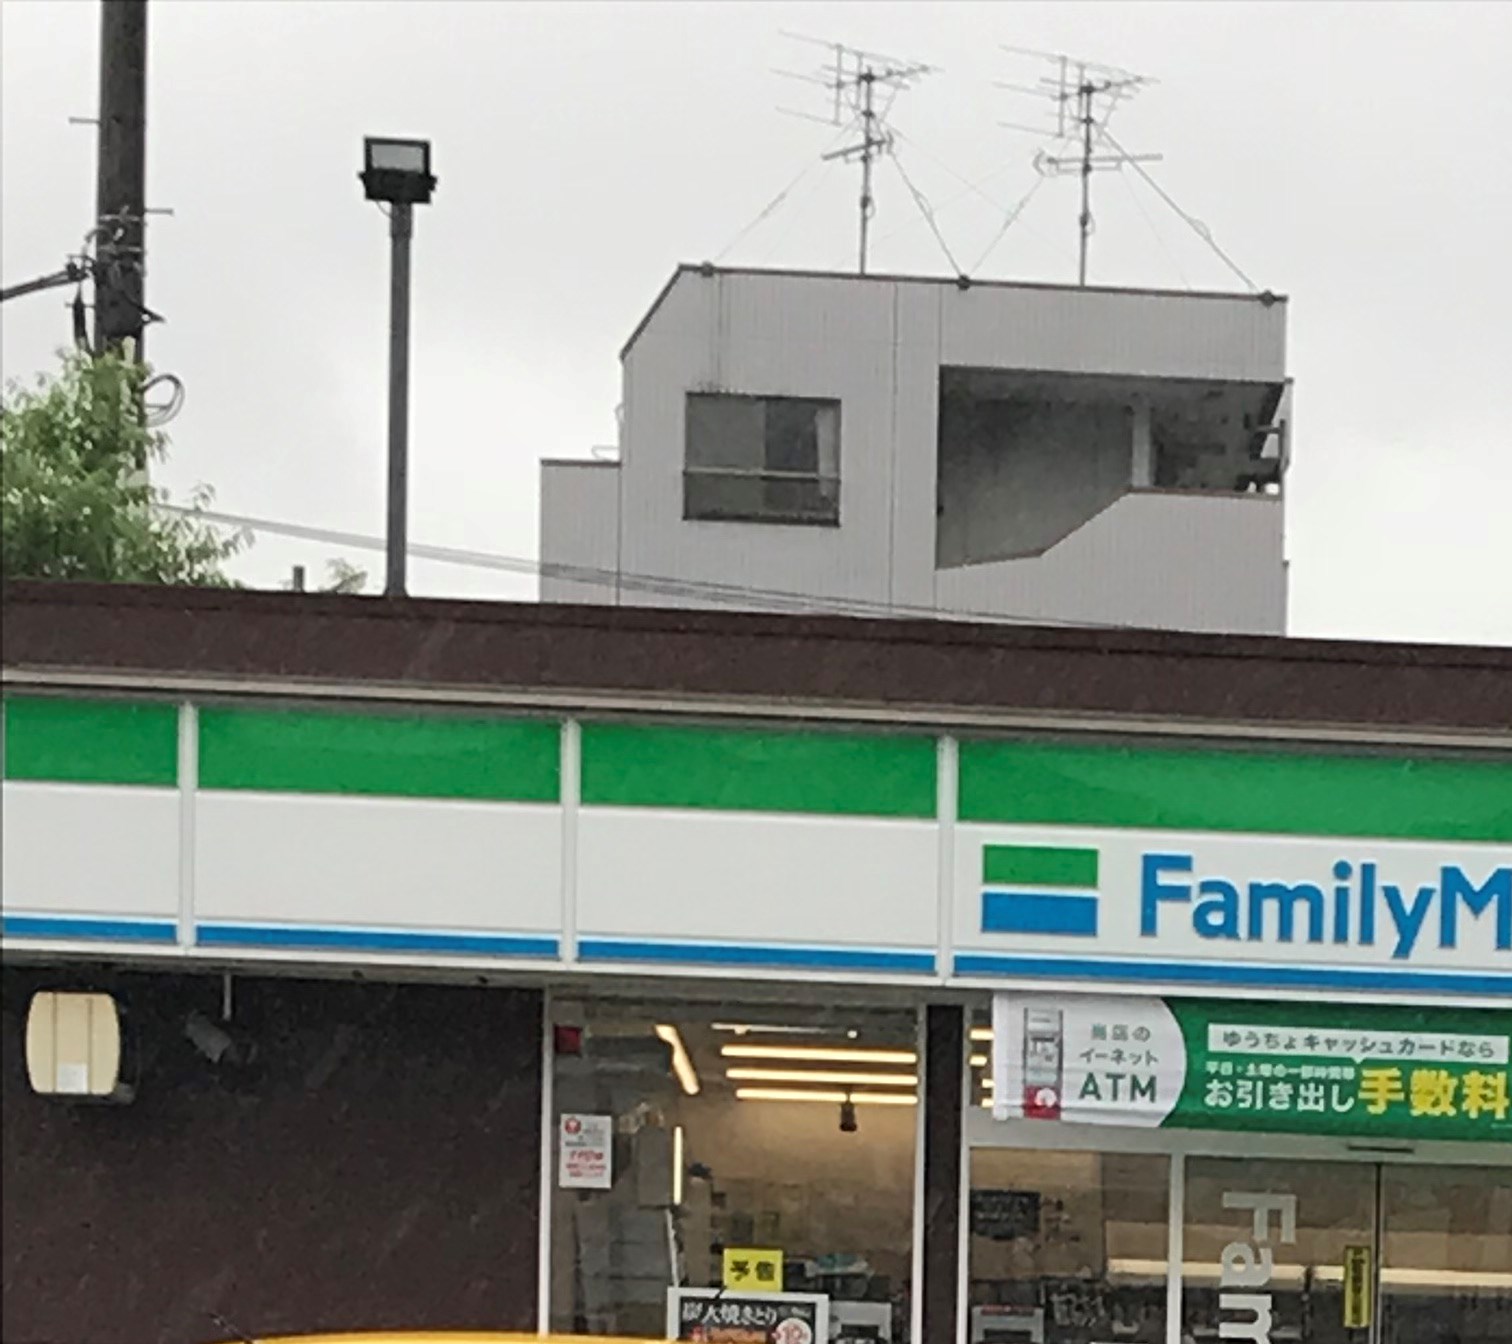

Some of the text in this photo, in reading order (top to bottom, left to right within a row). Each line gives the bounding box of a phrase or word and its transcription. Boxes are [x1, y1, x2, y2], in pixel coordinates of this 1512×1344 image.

[1091, 1024, 1151, 1043] 当店の
[1223, 1031, 1494, 1058] ゆうちょキャッシュカードなら
[1079, 1048, 1159, 1065] イーネット
[1078, 1073, 1157, 1104] ATM
